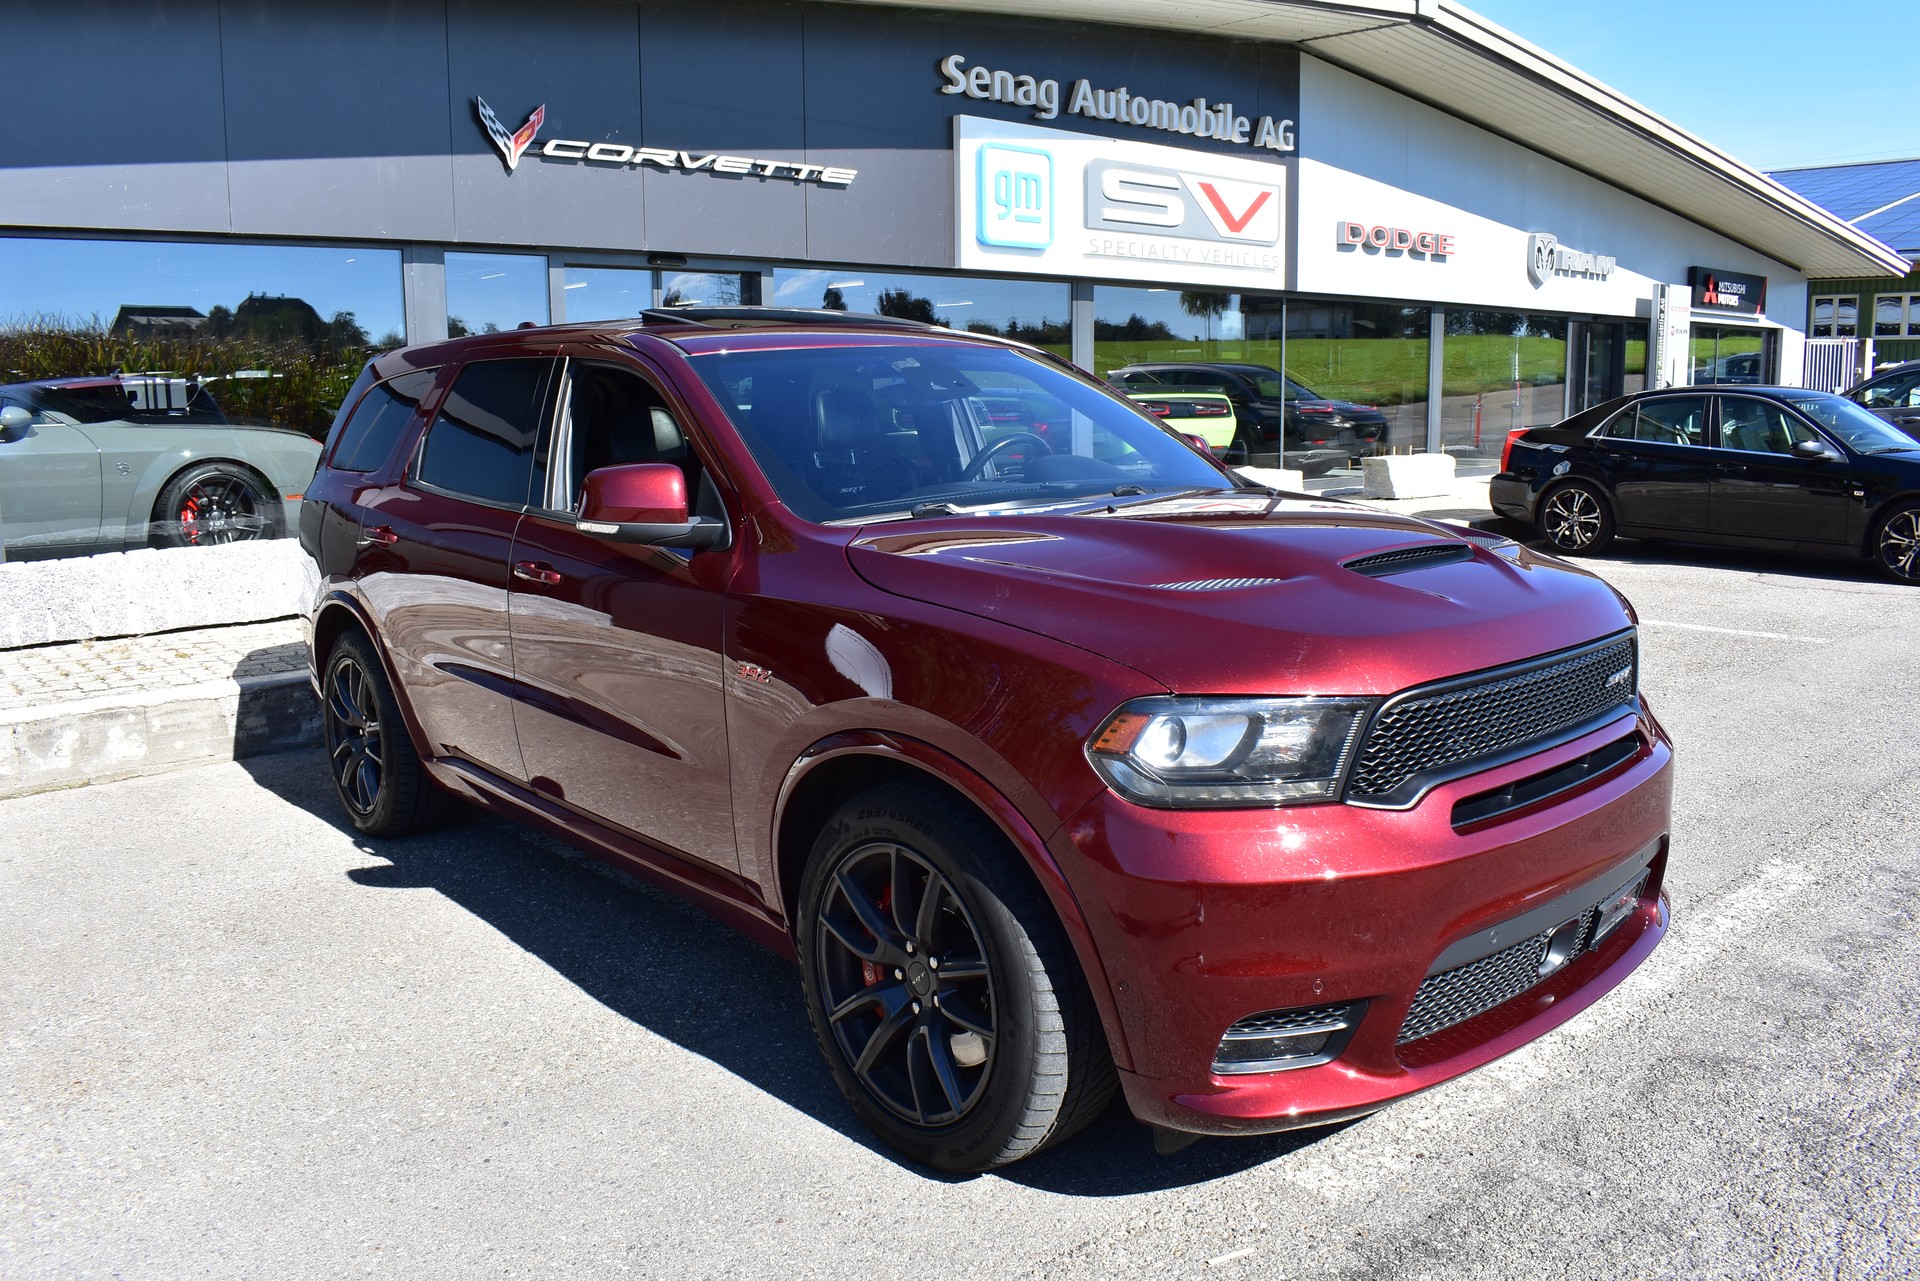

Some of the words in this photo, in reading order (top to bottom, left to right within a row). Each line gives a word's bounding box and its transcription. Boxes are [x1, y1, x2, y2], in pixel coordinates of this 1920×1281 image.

[941, 54, 1059, 119] Senag
[1067, 78, 1250, 144] Automobile
[1253, 115, 1294, 151] AG
[541, 138, 858, 185] CORVETTE
[995, 169, 1041, 222] gm
[1340, 221, 1455, 256] DODGE
[1090, 238, 1191, 261] SPECIALTY
[1200, 249, 1280, 269] VEHICLES
[1560, 250, 1616, 275] RAM
[1717, 293, 1739, 306] MOTORS
[1718, 281, 1746, 294] MITSUBISHI
[839, 485, 867, 494] SRT
[736, 664, 772, 684] 392
[857, 807, 934, 837] 295/45R20
[912, 970, 927, 985] SRT
